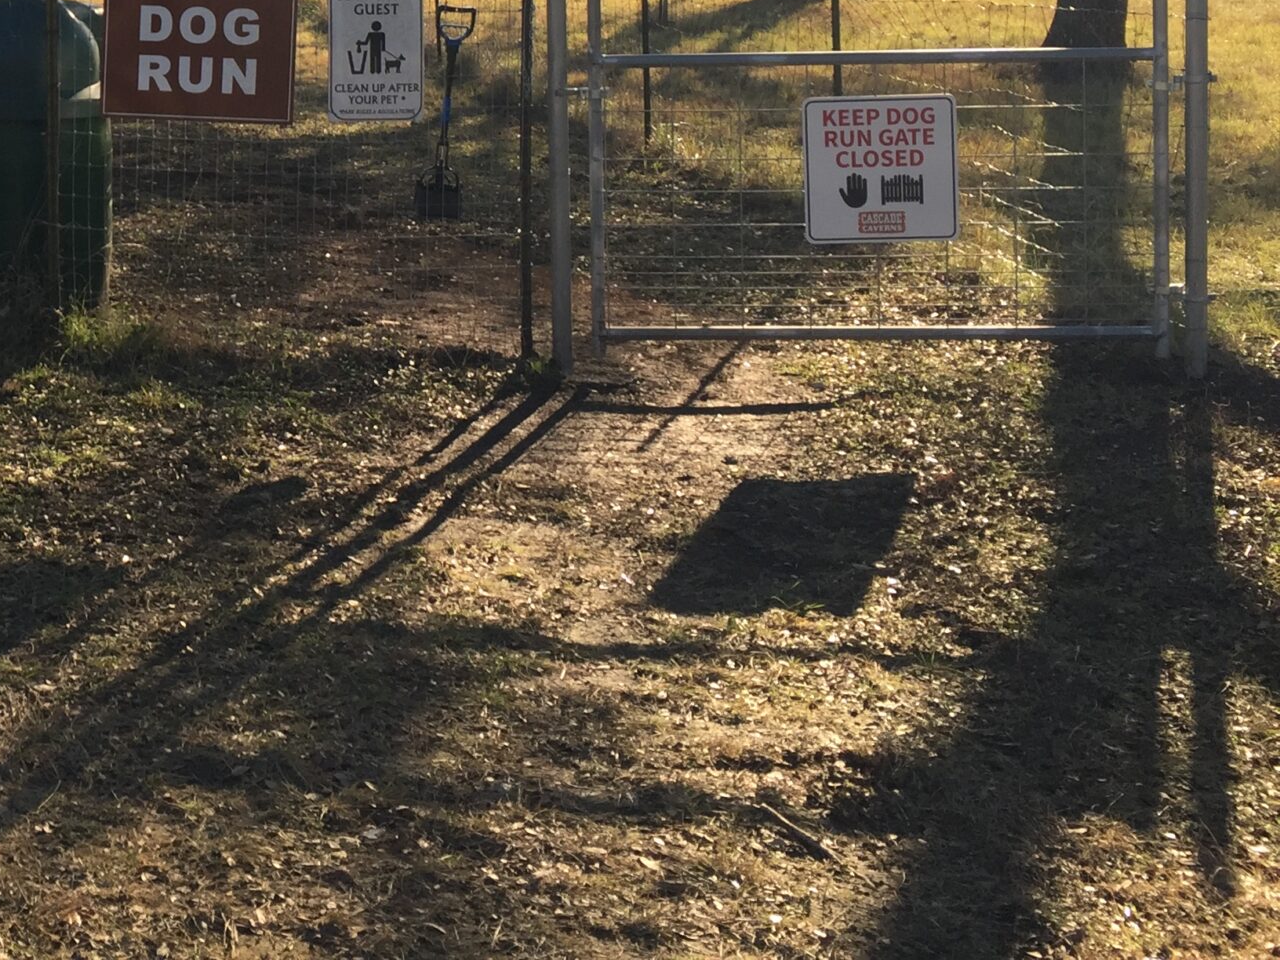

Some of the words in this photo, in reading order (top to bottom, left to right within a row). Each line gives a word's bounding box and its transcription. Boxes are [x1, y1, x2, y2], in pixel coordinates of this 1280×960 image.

[353, 3, 400, 15] GUEST
[139, 4, 260, 46] DOG
[137, 54, 258, 96] RUN
[334, 83, 369, 93] CLEAN
[372, 83, 386, 93] UP
[388, 83, 420, 93] AFTER
[348, 95, 378, 105] YOUR
[380, 95, 399, 105] PET
[822, 108, 880, 127] KEEP
[886, 107, 935, 126] DOG
[824, 129, 872, 148] RUN
[878, 128, 935, 146] GATE
[835, 149, 924, 168] CLOSED
[861, 212, 904, 224] CASCADE
[862, 224, 903, 232] CAVERNS
